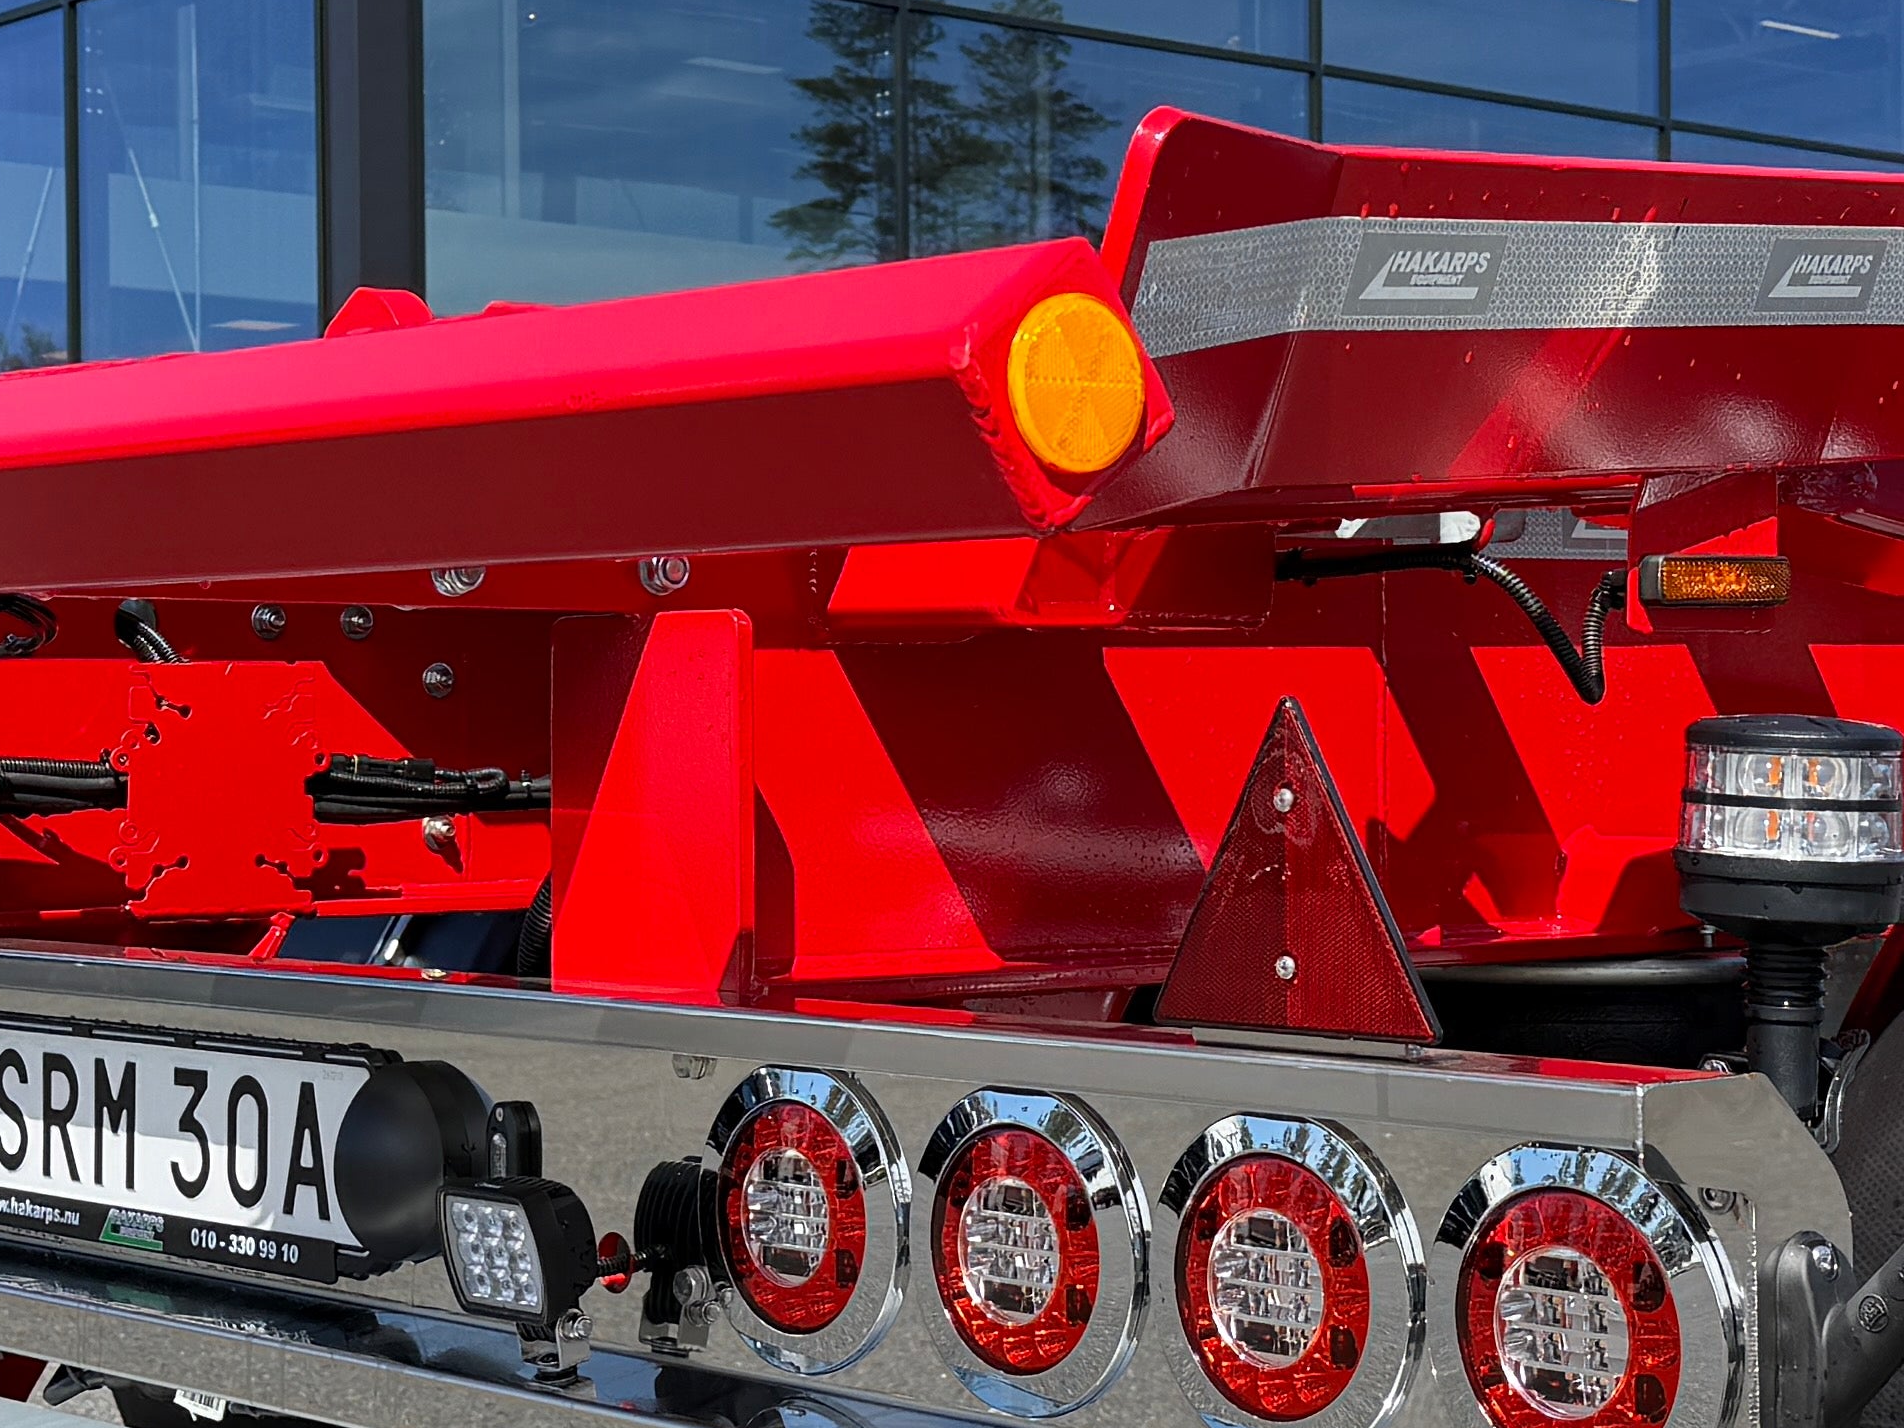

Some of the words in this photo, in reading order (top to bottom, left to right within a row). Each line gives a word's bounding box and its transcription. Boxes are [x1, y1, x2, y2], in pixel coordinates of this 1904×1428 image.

[1392, 251, 1491, 273] HAKARPS
[1794, 254, 1874, 274] HAKARPS
[170, 1066, 331, 1222] 30A
[190, 1227, 217, 1250] 010
[228, 1233, 256, 1256] 330
[258, 1239, 277, 1260] 99
[281, 1241, 299, 1264] 10
